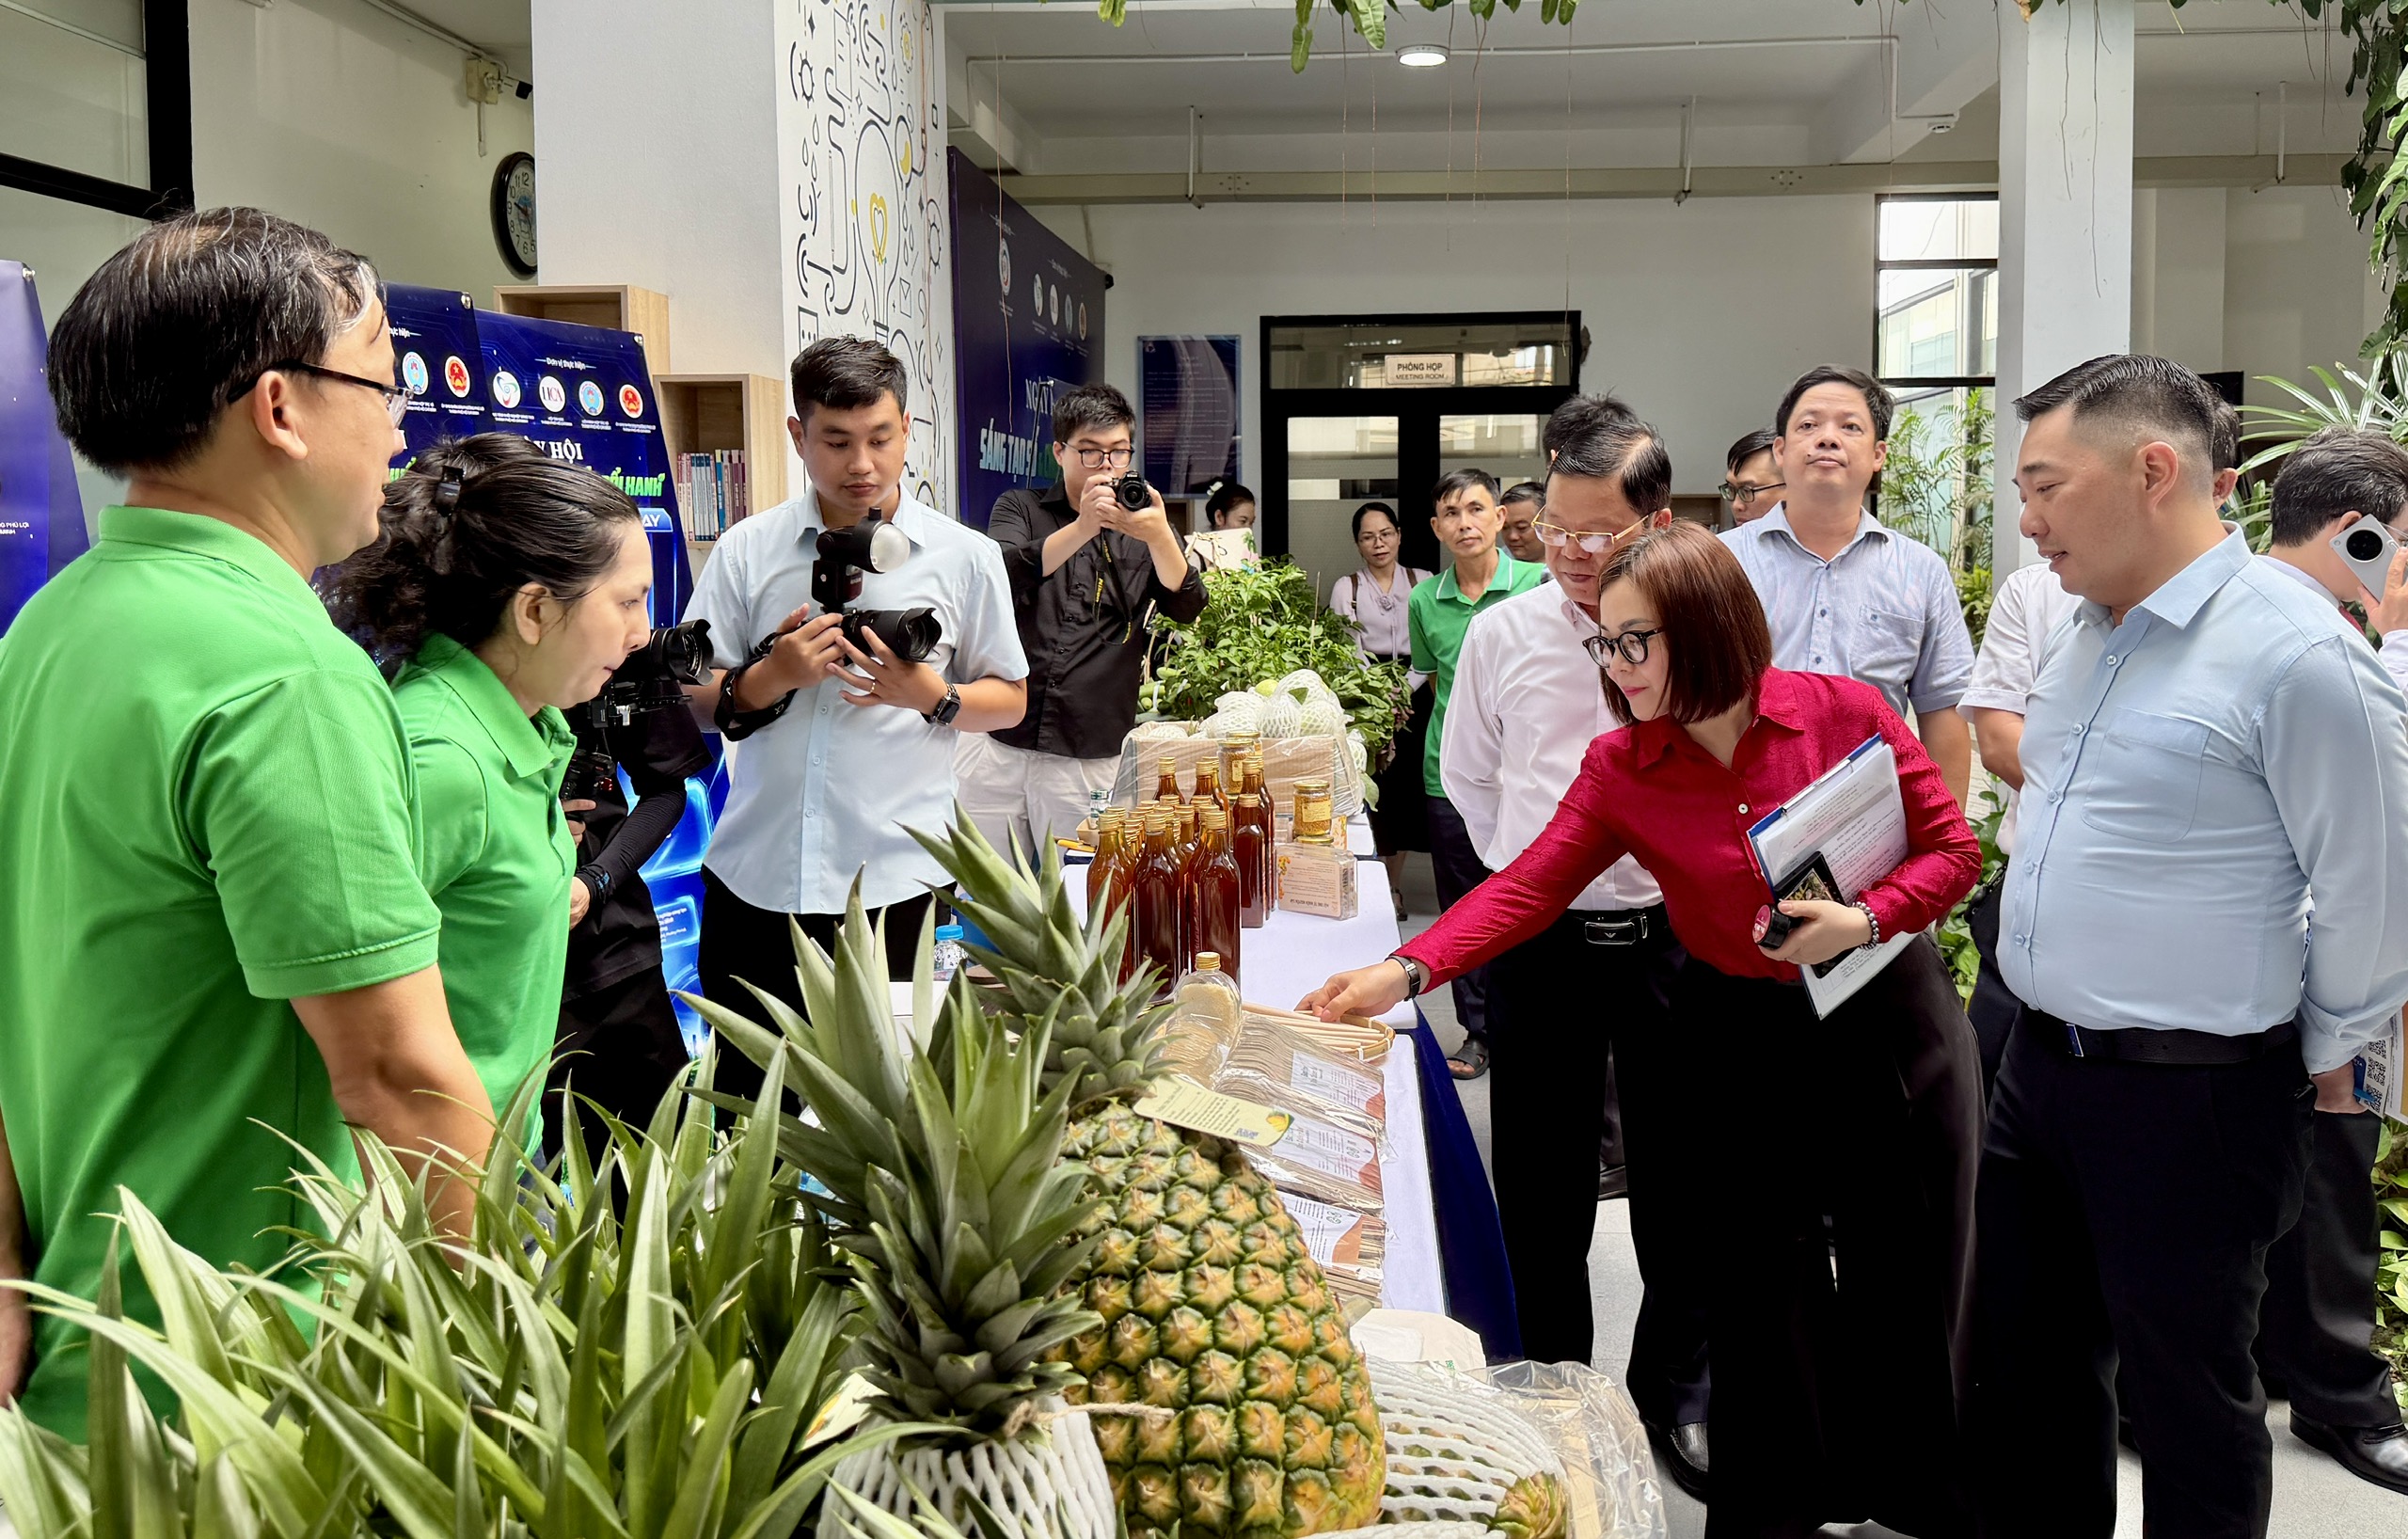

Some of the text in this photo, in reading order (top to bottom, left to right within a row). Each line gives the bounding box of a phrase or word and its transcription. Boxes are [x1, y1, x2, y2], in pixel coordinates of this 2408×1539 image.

[515, 173, 521, 187] 11
[522, 171, 530, 186] 12
[548, 437, 584, 464] HỘI
[979, 418, 1006, 474] SÁNG
[1007, 434, 1026, 483] TẠO
